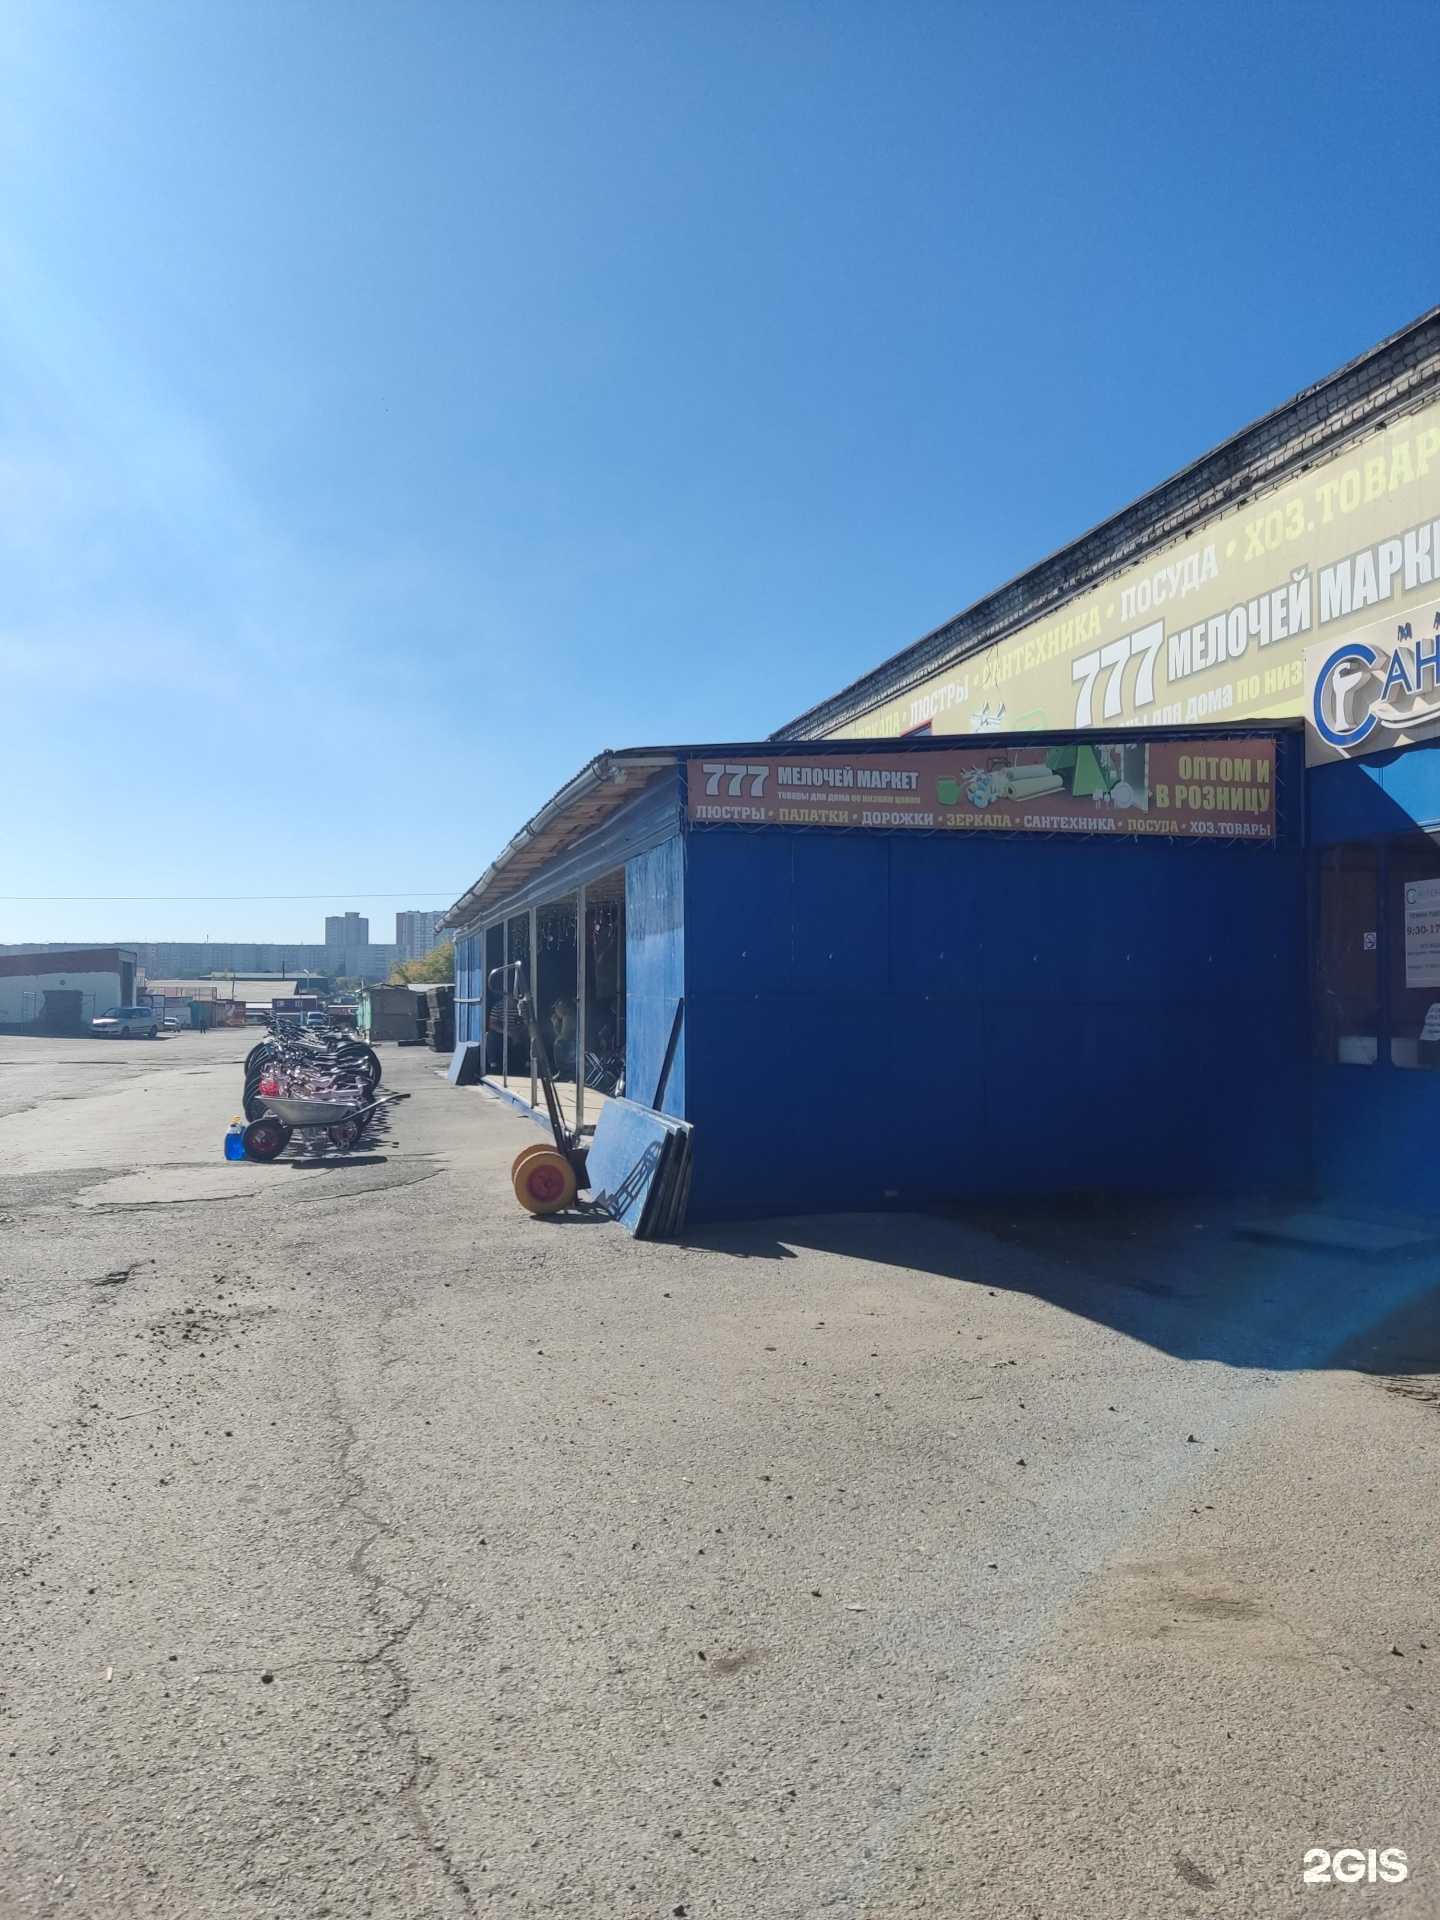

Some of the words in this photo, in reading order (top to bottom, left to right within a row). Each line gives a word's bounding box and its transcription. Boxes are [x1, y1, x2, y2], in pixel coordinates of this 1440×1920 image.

[983, 604, 1100, 689] САНТЕХНИКА
[1120, 543, 1219, 624] ПОСУДА
[1072, 617, 1165, 728] 777
[1168, 566, 1312, 682] МЕЛОЧЕЙ
[702, 763, 770, 798] 777
[777, 767, 854, 788] МЕЛОЧЕЙ
[857, 770, 919, 790] МАРКЕТ
[1178, 755, 1252, 783] ОПТОМ
[1256, 759, 1270, 783] И
[1156, 784, 1170, 809] В
[1175, 786, 1271, 815] РОЗНИЦУ
[696, 805, 766, 821] ЛЮСТРЫ
[779, 808, 849, 824] ПАЛАТКИ
[862, 811, 934, 826] ДОРОЖКИ
[946, 813, 1012, 828] ЗЕРКАЛА
[1023, 816, 1117, 831] САНТЕХНИКА
[1127, 819, 1179, 833] ПОСУДА
[1189, 822, 1272, 836] ХОЗ.ТОВАРЫ
